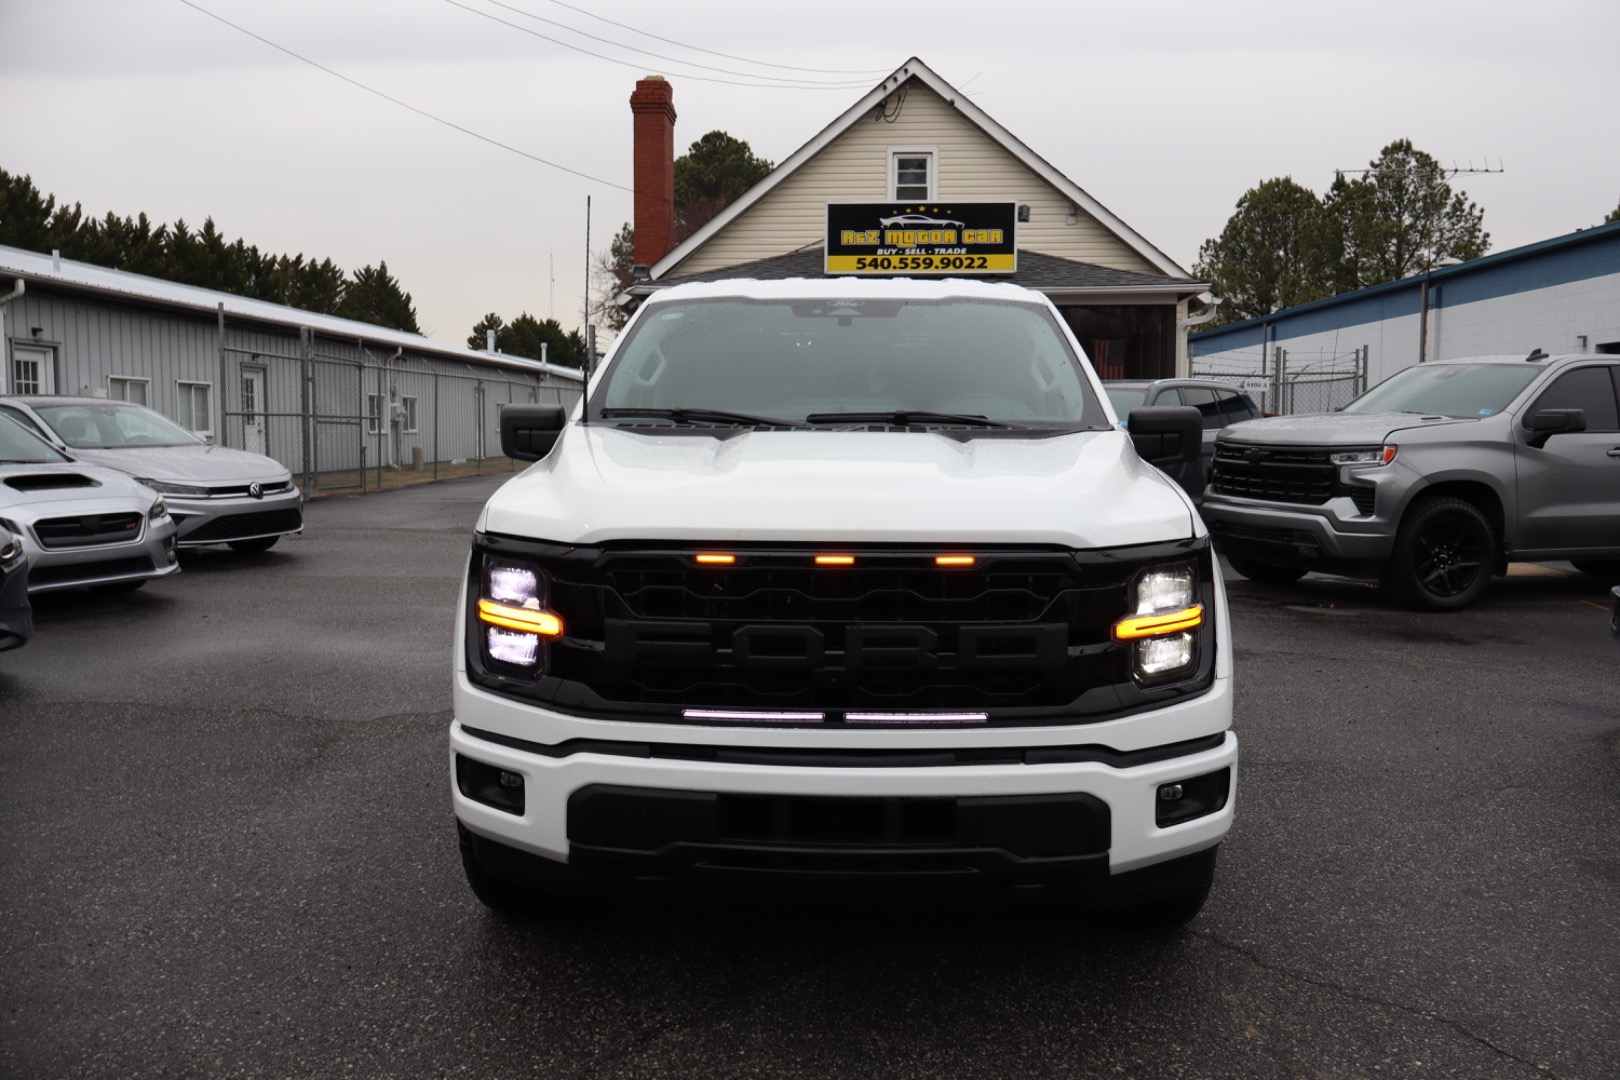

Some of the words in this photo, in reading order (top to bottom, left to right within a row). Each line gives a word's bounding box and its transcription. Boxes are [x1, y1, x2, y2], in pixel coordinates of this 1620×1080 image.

[885, 229, 957, 248] MOTOR
[855, 257, 988, 270] 540.559.9022
[604, 618, 1068, 671] FORD
